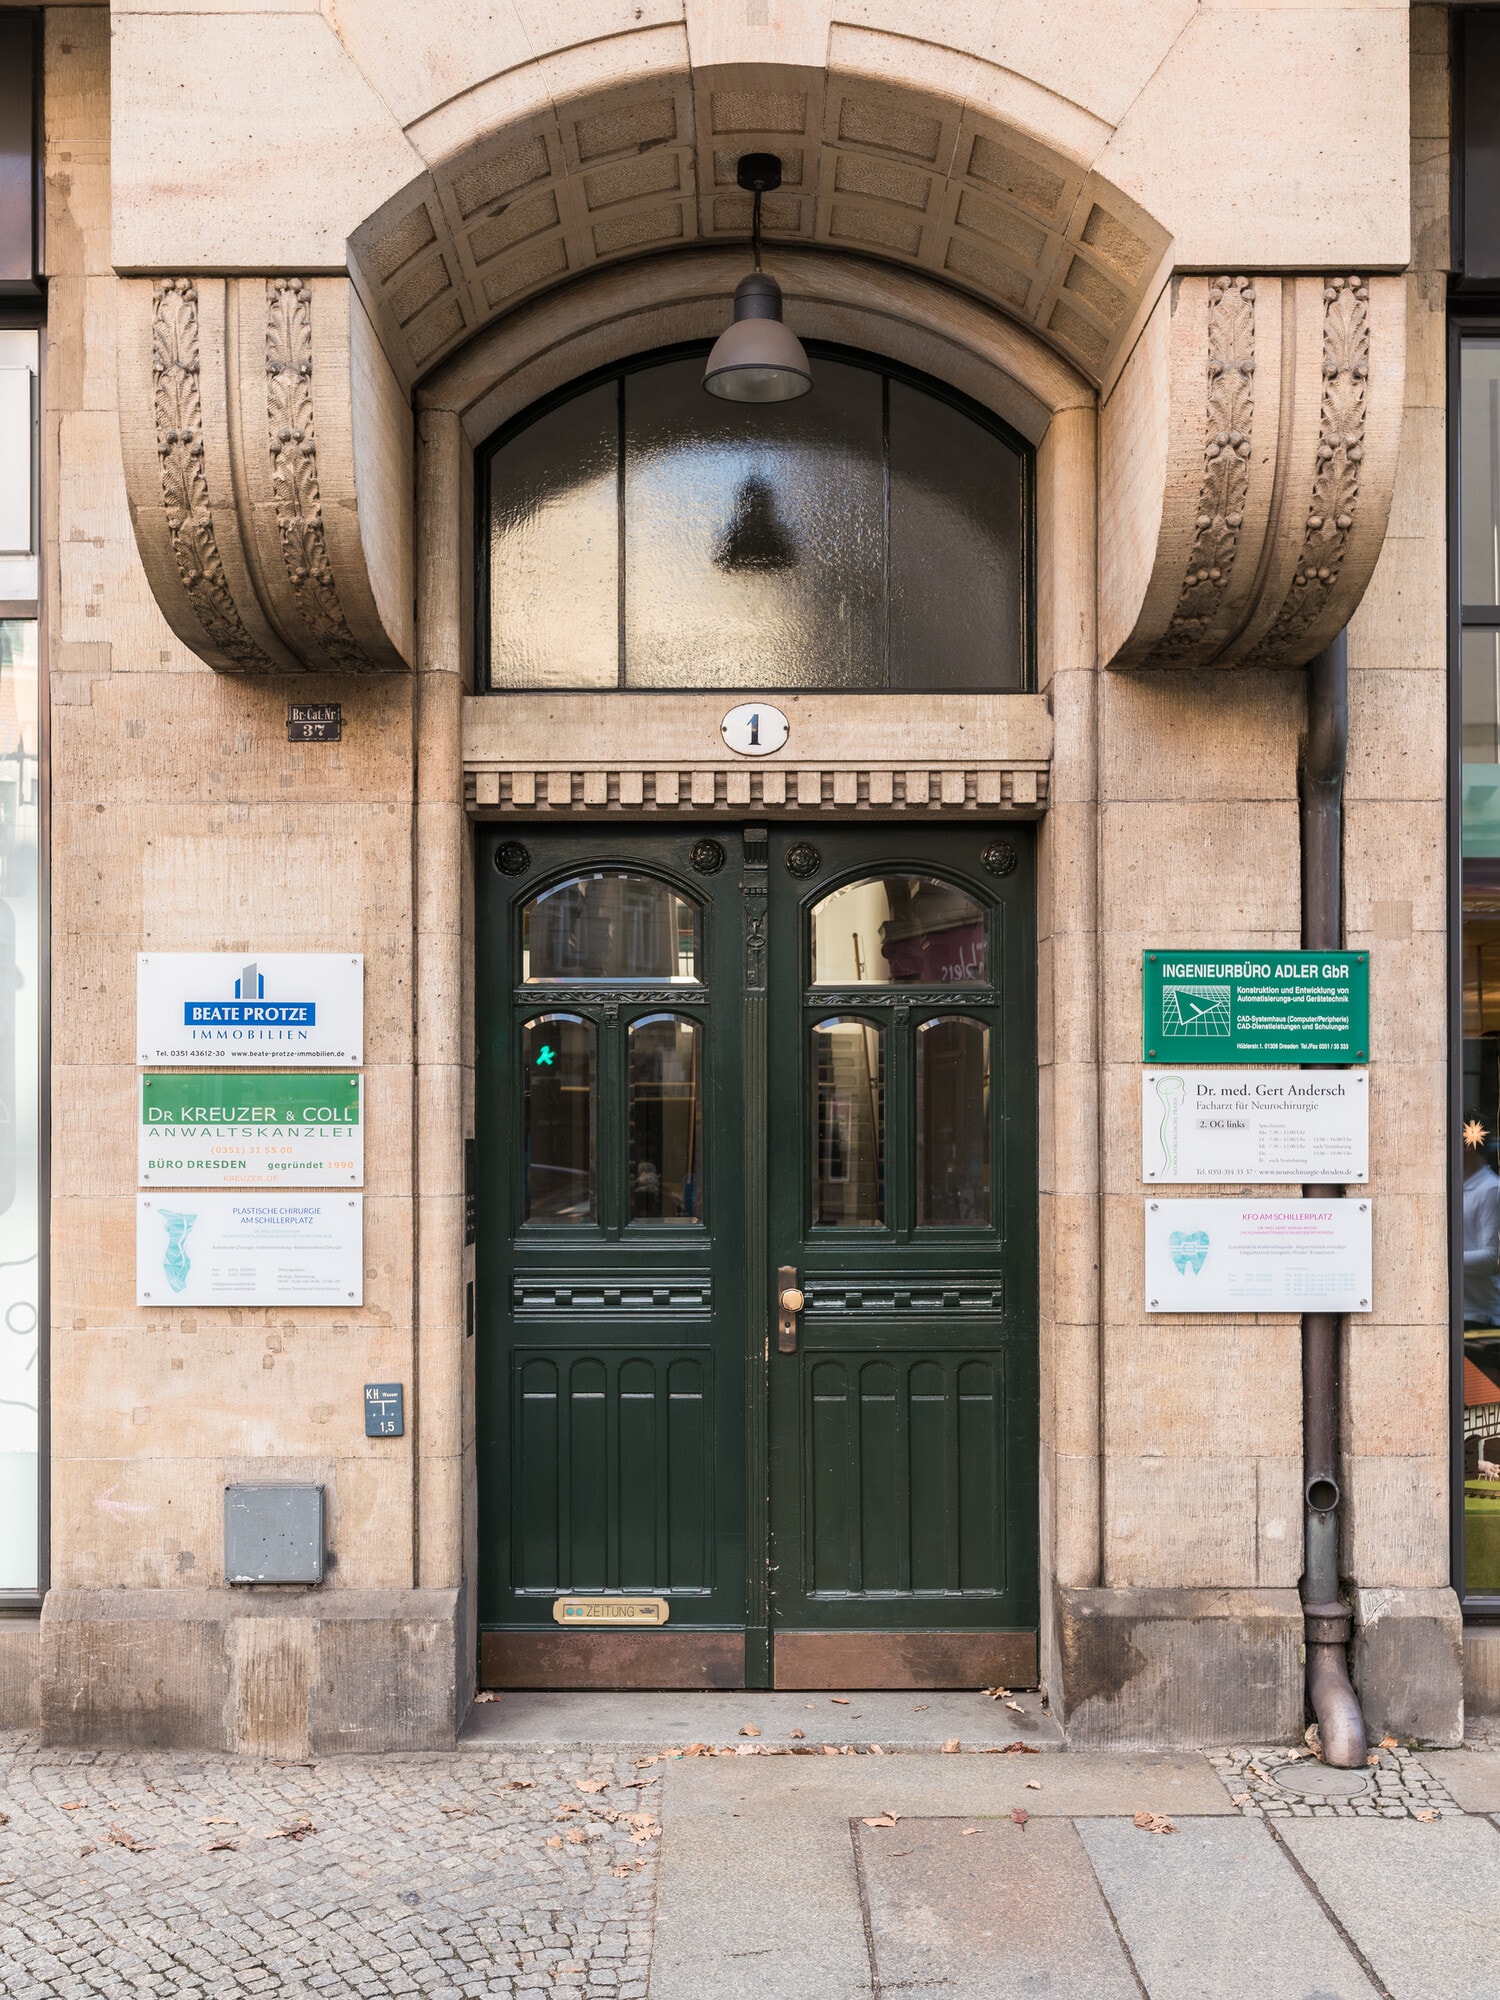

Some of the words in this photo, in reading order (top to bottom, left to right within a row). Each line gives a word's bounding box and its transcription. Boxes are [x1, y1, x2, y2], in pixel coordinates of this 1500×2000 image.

[303, 724, 325, 737] 37
[746, 714, 762, 746] 1
[1163, 961, 1271, 978] INGENIEURBÜRO
[1274, 964, 1319, 978] ADLER
[1322, 964, 1349, 978] GbR
[1237, 986, 1279, 994] Konstruktion
[1281, 986, 1294, 994] und
[1295, 986, 1336, 995] Entwicklung
[192, 1008, 239, 1021] BEATE
[244, 1008, 307, 1021] PROTZE
[1287, 1016, 1349, 1024] (Computer/Peripherie)
[192, 1030, 308, 1040] IMMOBILIEN
[231, 1050, 345, 1058] www.beate-protze-immobilien.de
[1196, 1084, 1216, 1096] Dr.
[1221, 1084, 1251, 1096] med.
[1256, 1084, 1284, 1096] Gert
[1288, 1084, 1346, 1096] Andersch
[1196, 1101, 1233, 1110] Facharzt
[1236, 1101, 1248, 1110] für
[1251, 1101, 1319, 1112] Neurochirurgie
[182, 1108, 278, 1121] KREUZER
[286, 1111, 296, 1122] &
[303, 1108, 353, 1122] COLL
[1200, 1120, 1207, 1128] 2.
[1210, 1120, 1225, 1128] OG
[1227, 1120, 1246, 1128] links
[148, 1128, 353, 1137] ANWALTSKANZLEI
[210, 1146, 245, 1155] (0351)
[148, 1158, 183, 1169] BÜRO
[188, 1161, 246, 1169] DRESDEN
[268, 1161, 323, 1170] gegründet
[328, 1161, 354, 1169] 1990
[366, 1389, 379, 1400] KH
[380, 1421, 395, 1434] 1,5
[586, 1606, 635, 1618] ZEITUNG
